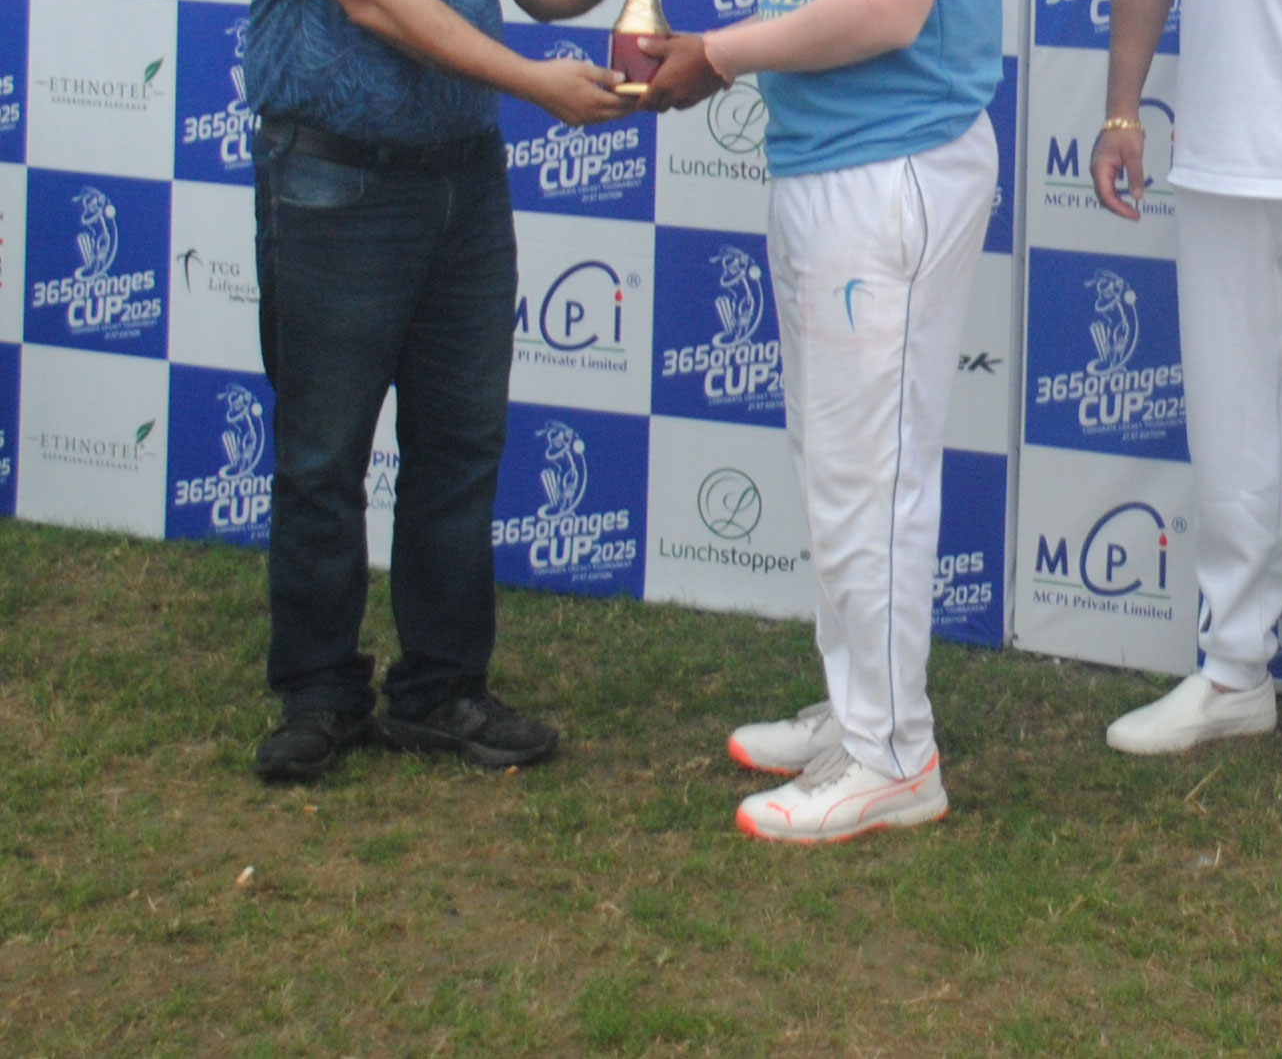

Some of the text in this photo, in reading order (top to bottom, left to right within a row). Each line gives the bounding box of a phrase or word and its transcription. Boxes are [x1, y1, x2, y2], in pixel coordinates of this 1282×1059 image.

[50, 77, 151, 100] ETHNOTEL
[669, 153, 770, 186] Lunchstop
[210, 261, 240, 276] TCG
[32, 270, 154, 307] 365oranges
[534, 349, 625, 373] Private Limited
[41, 433, 141, 460] ETHNOTEL
[488, 509, 628, 546] 365oranges
[1033, 591, 1171, 621] MCPI Private Limited
